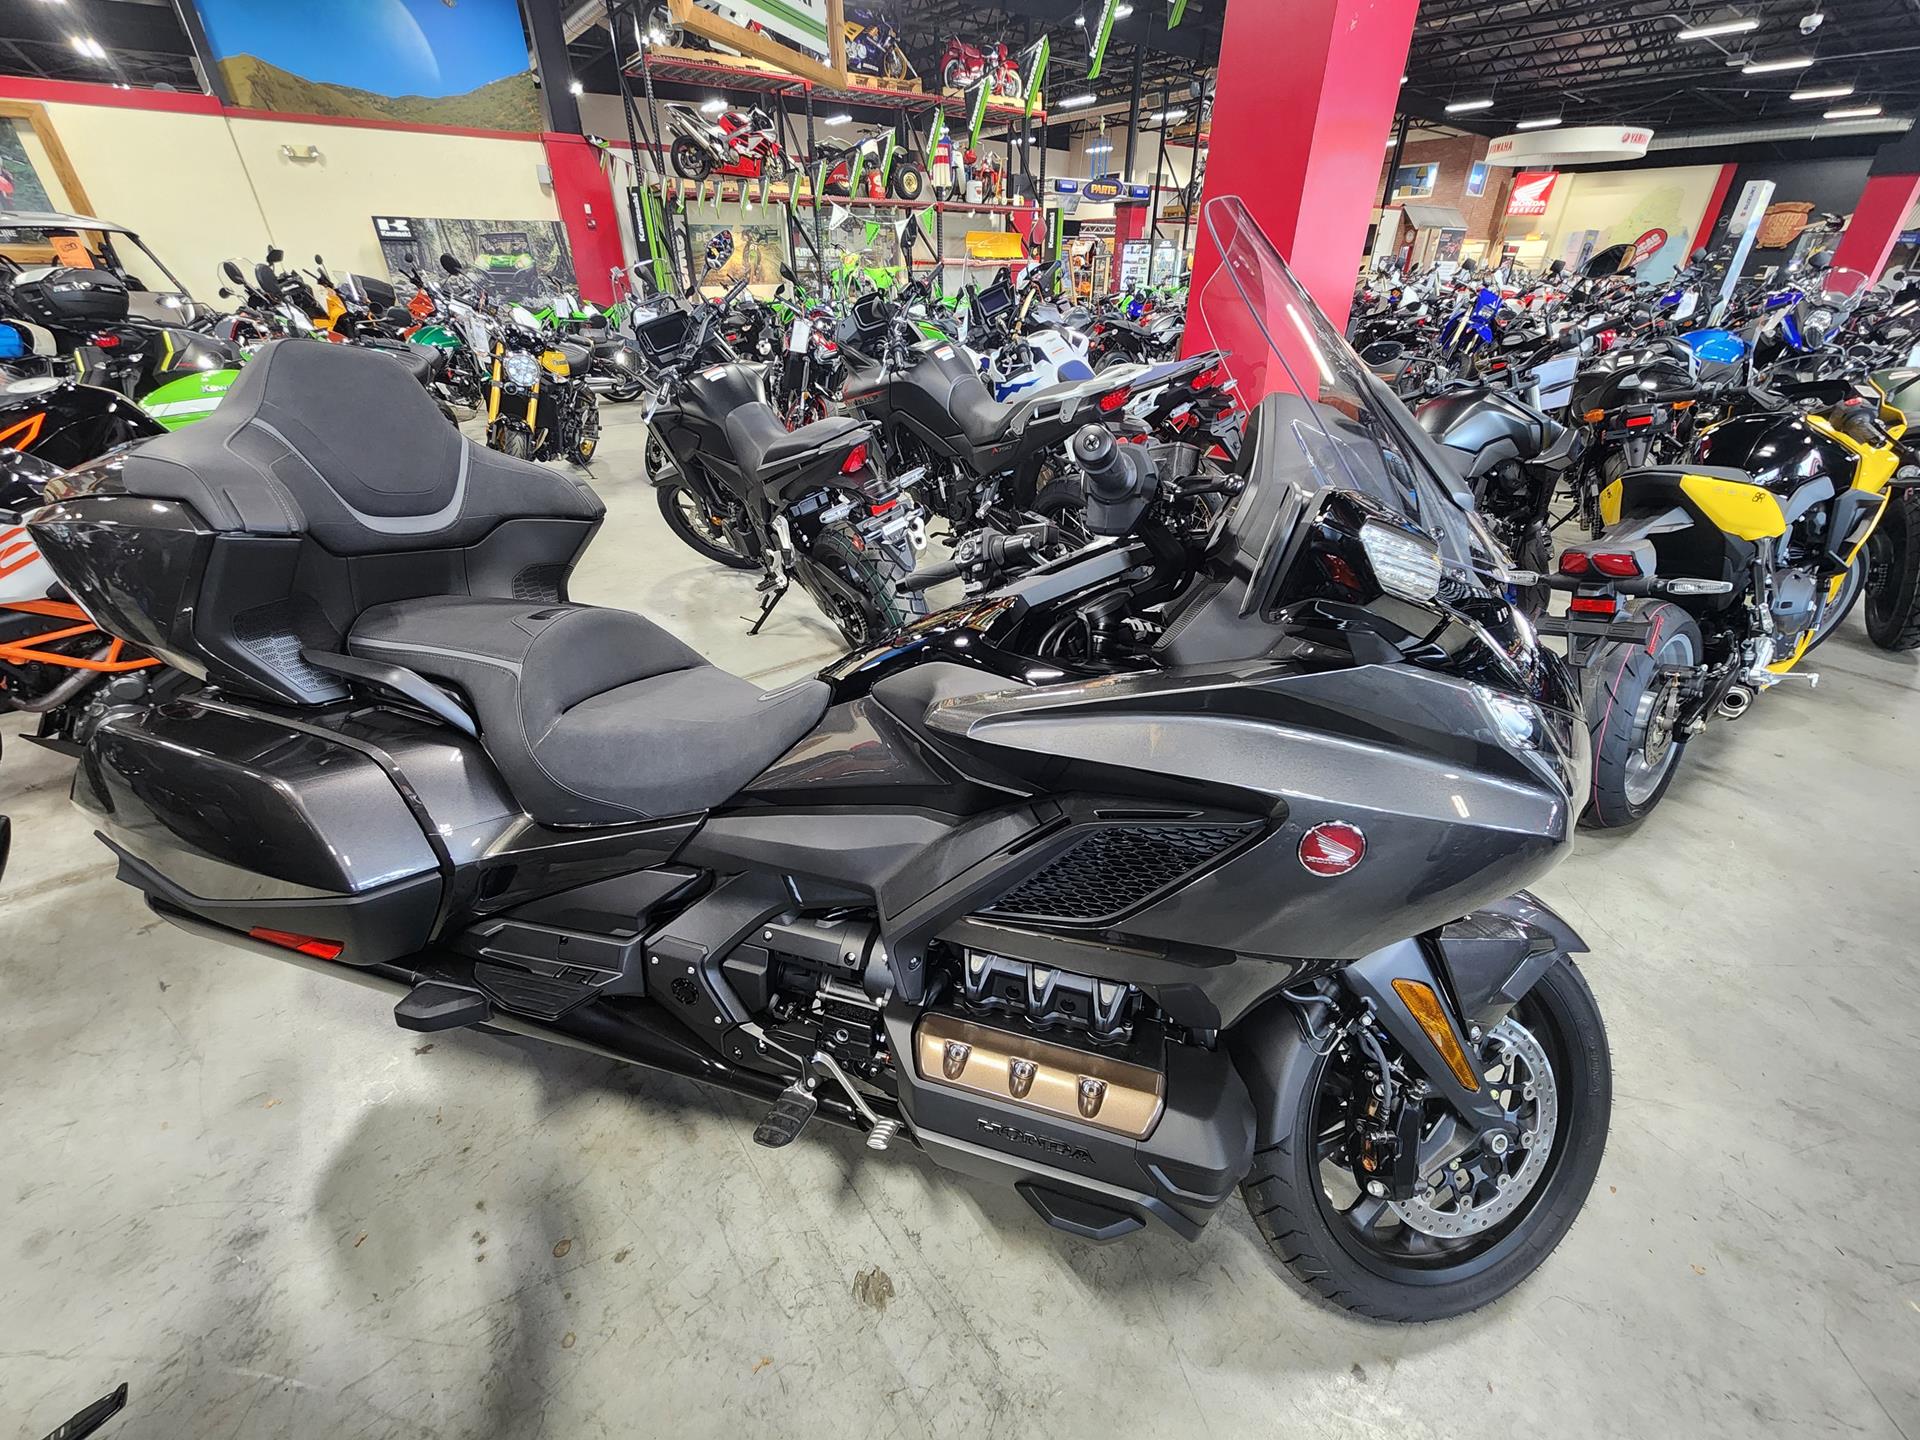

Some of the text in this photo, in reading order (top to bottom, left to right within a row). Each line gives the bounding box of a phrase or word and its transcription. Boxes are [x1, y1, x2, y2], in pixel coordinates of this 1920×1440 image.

[1090, 183, 1118, 195] PARTS
[631, 192, 646, 242] Kawasaki
[1305, 855, 1351, 867] HONDA
[976, 1118, 1097, 1164] HONDA
